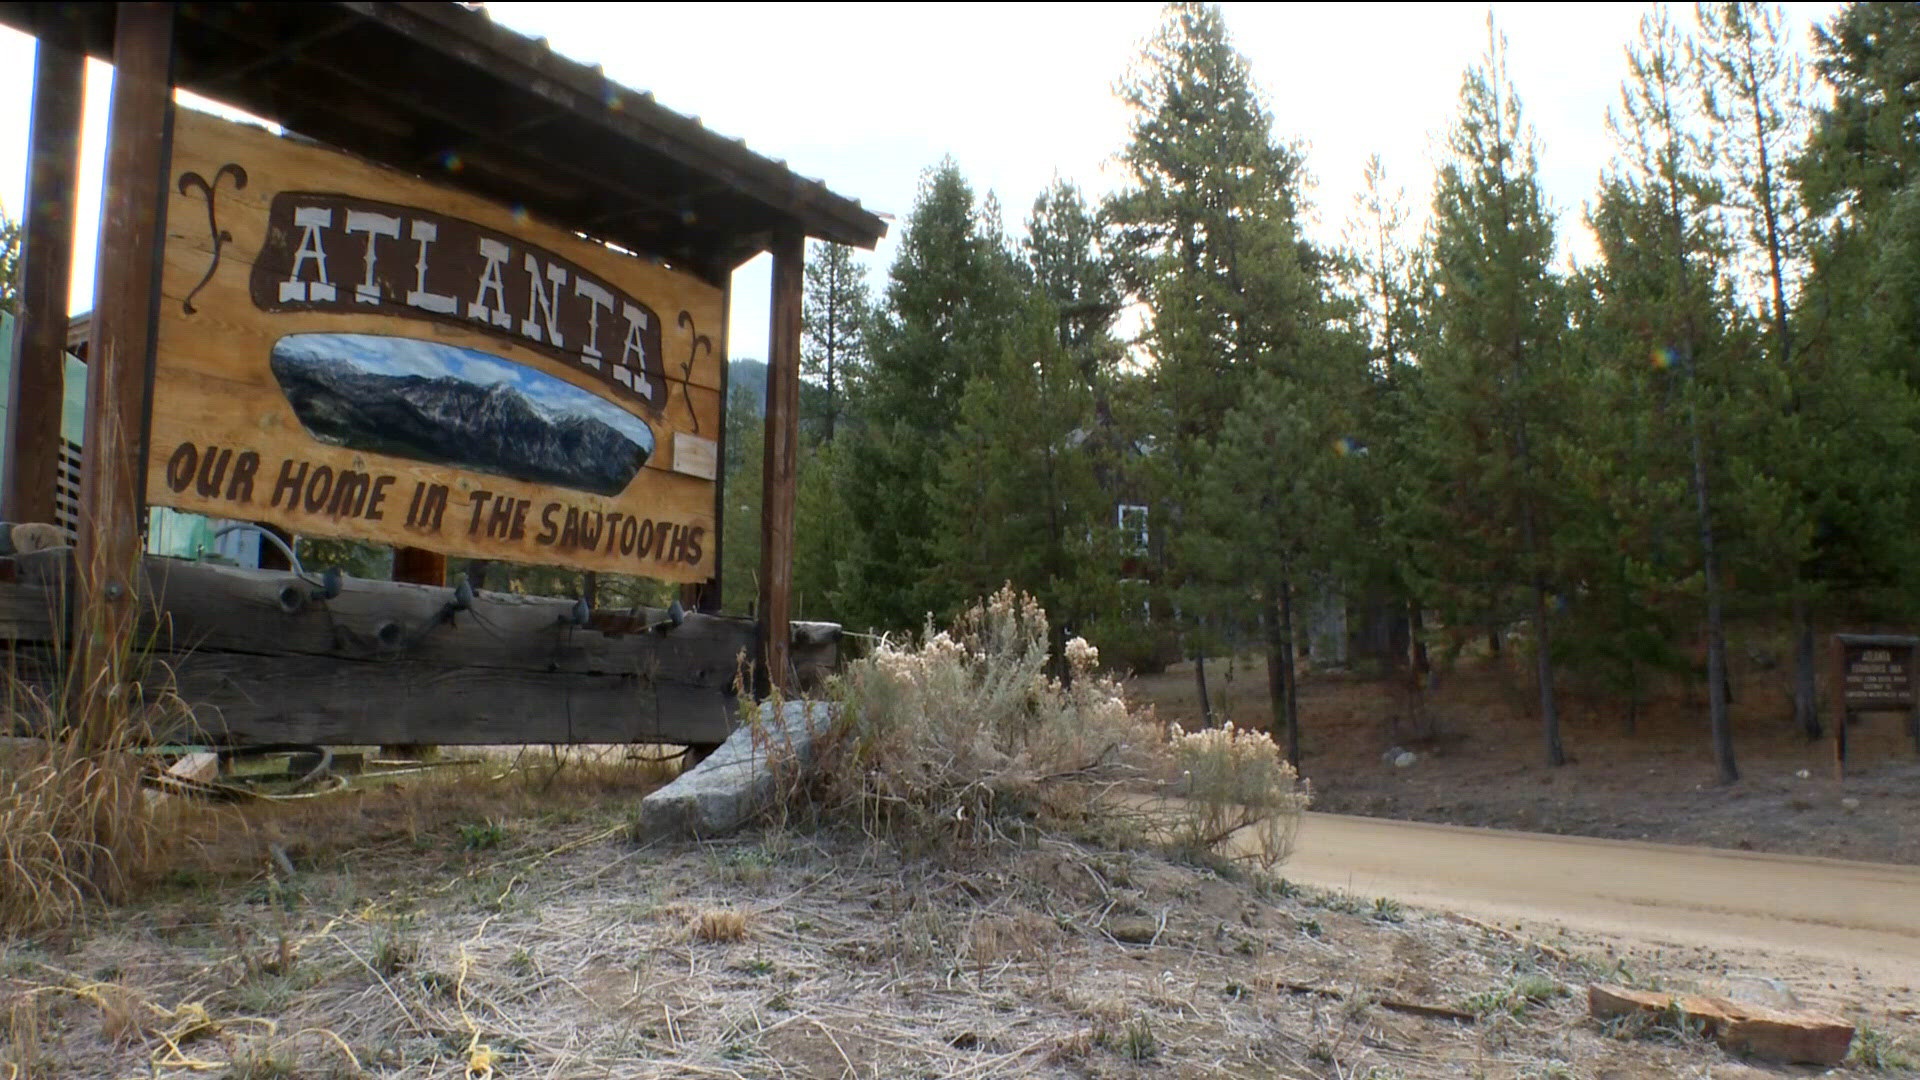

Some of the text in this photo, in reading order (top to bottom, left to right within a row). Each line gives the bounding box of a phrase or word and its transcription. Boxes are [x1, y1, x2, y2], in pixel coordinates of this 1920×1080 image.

[279, 206, 652, 400] ATLANTA
[166, 442, 705, 565] OUR HOME IN THE SAWTOOTHS
